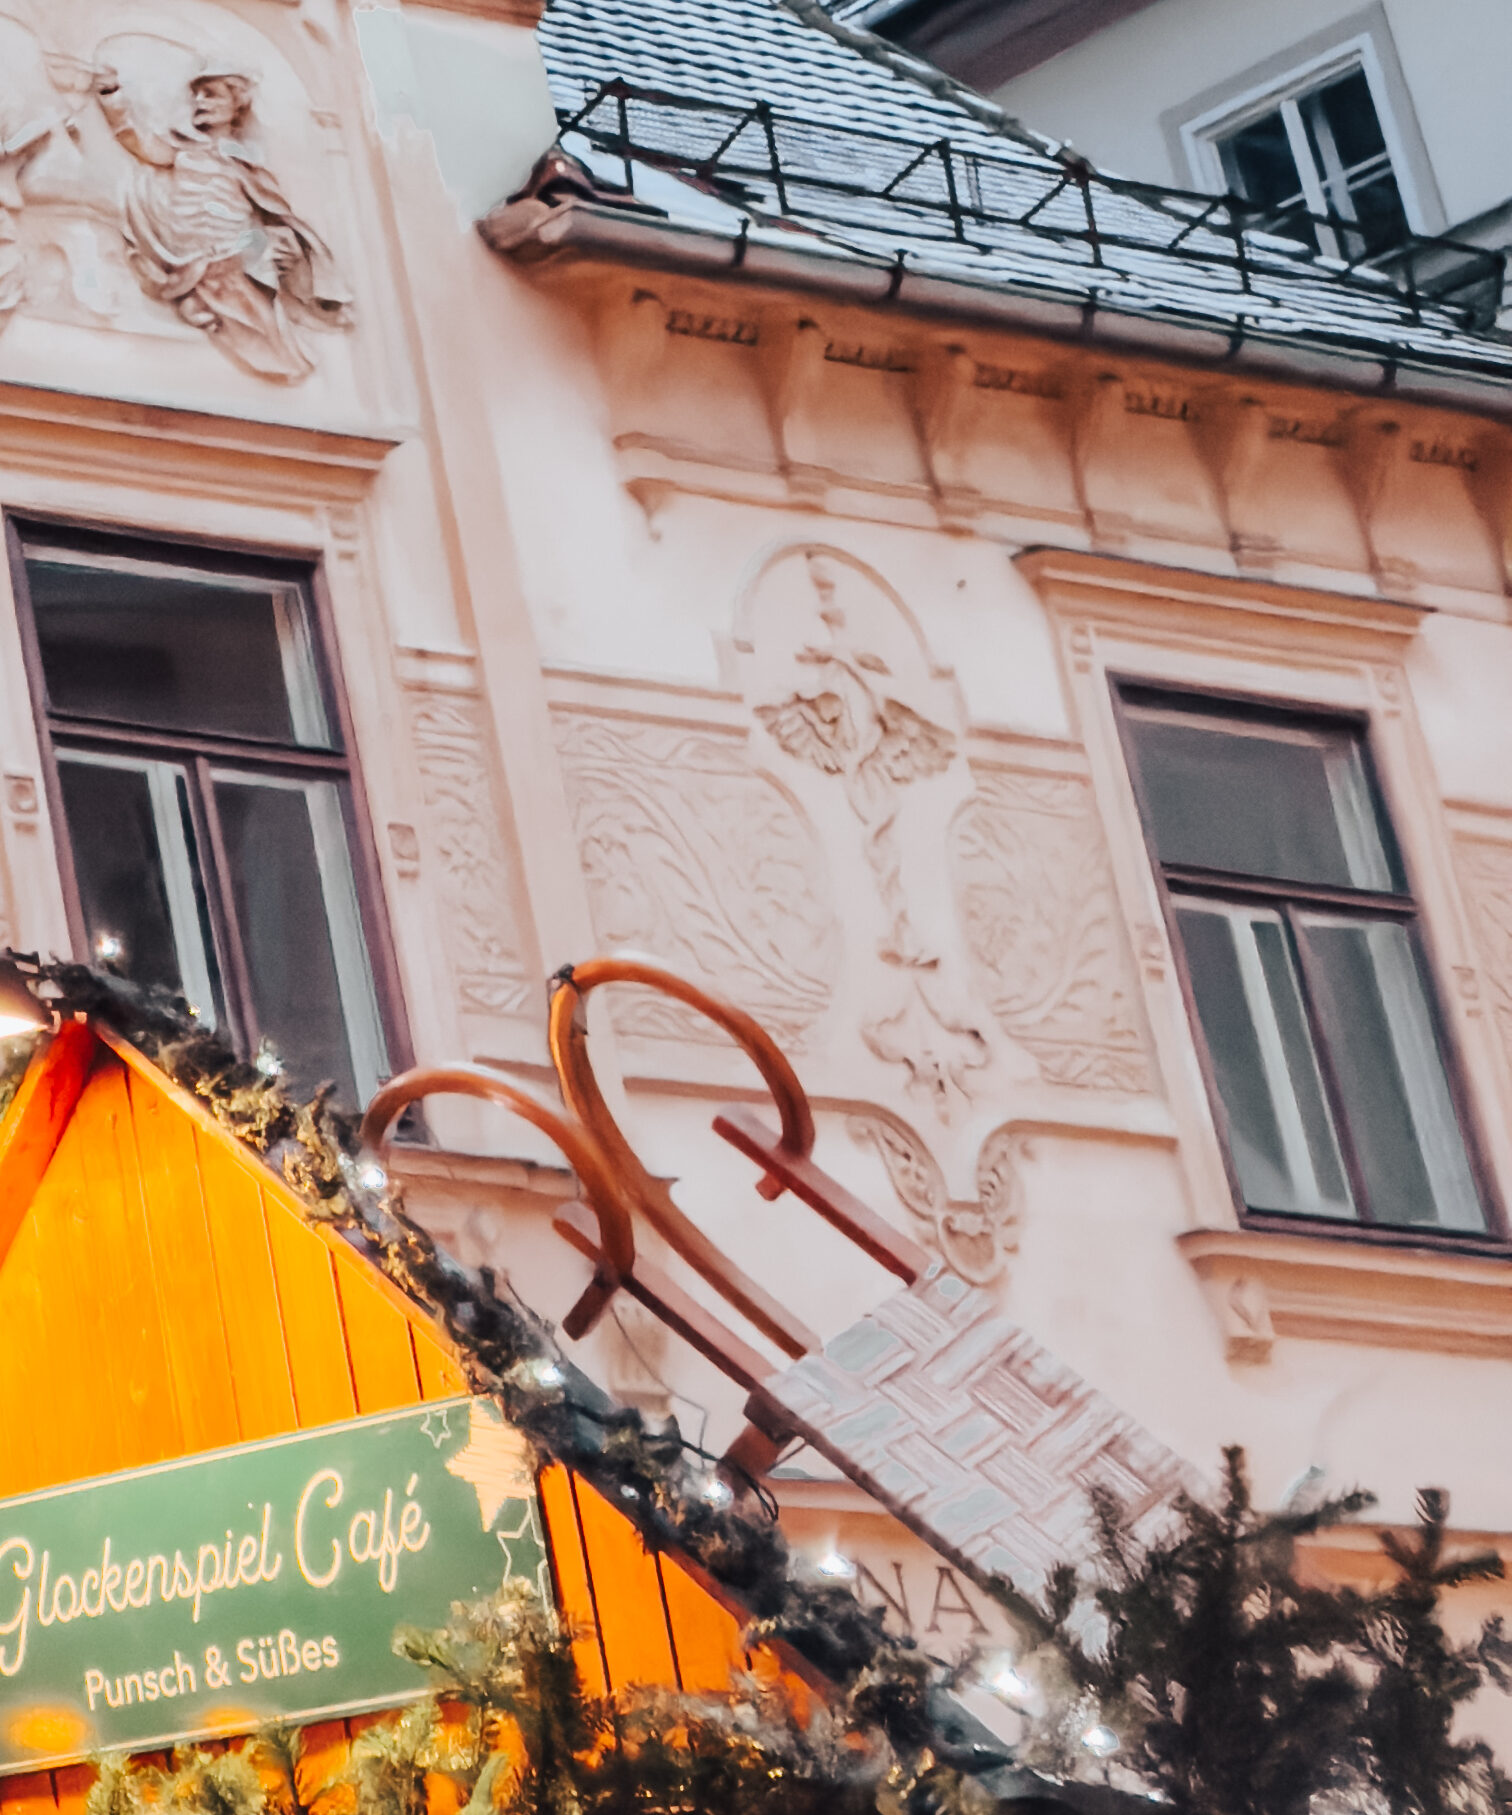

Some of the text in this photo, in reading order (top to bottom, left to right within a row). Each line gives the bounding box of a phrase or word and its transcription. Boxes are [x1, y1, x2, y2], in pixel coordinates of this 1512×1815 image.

[294, 1467, 432, 1594] Café
[85, 1628, 342, 1712] Punsch & Süßes
